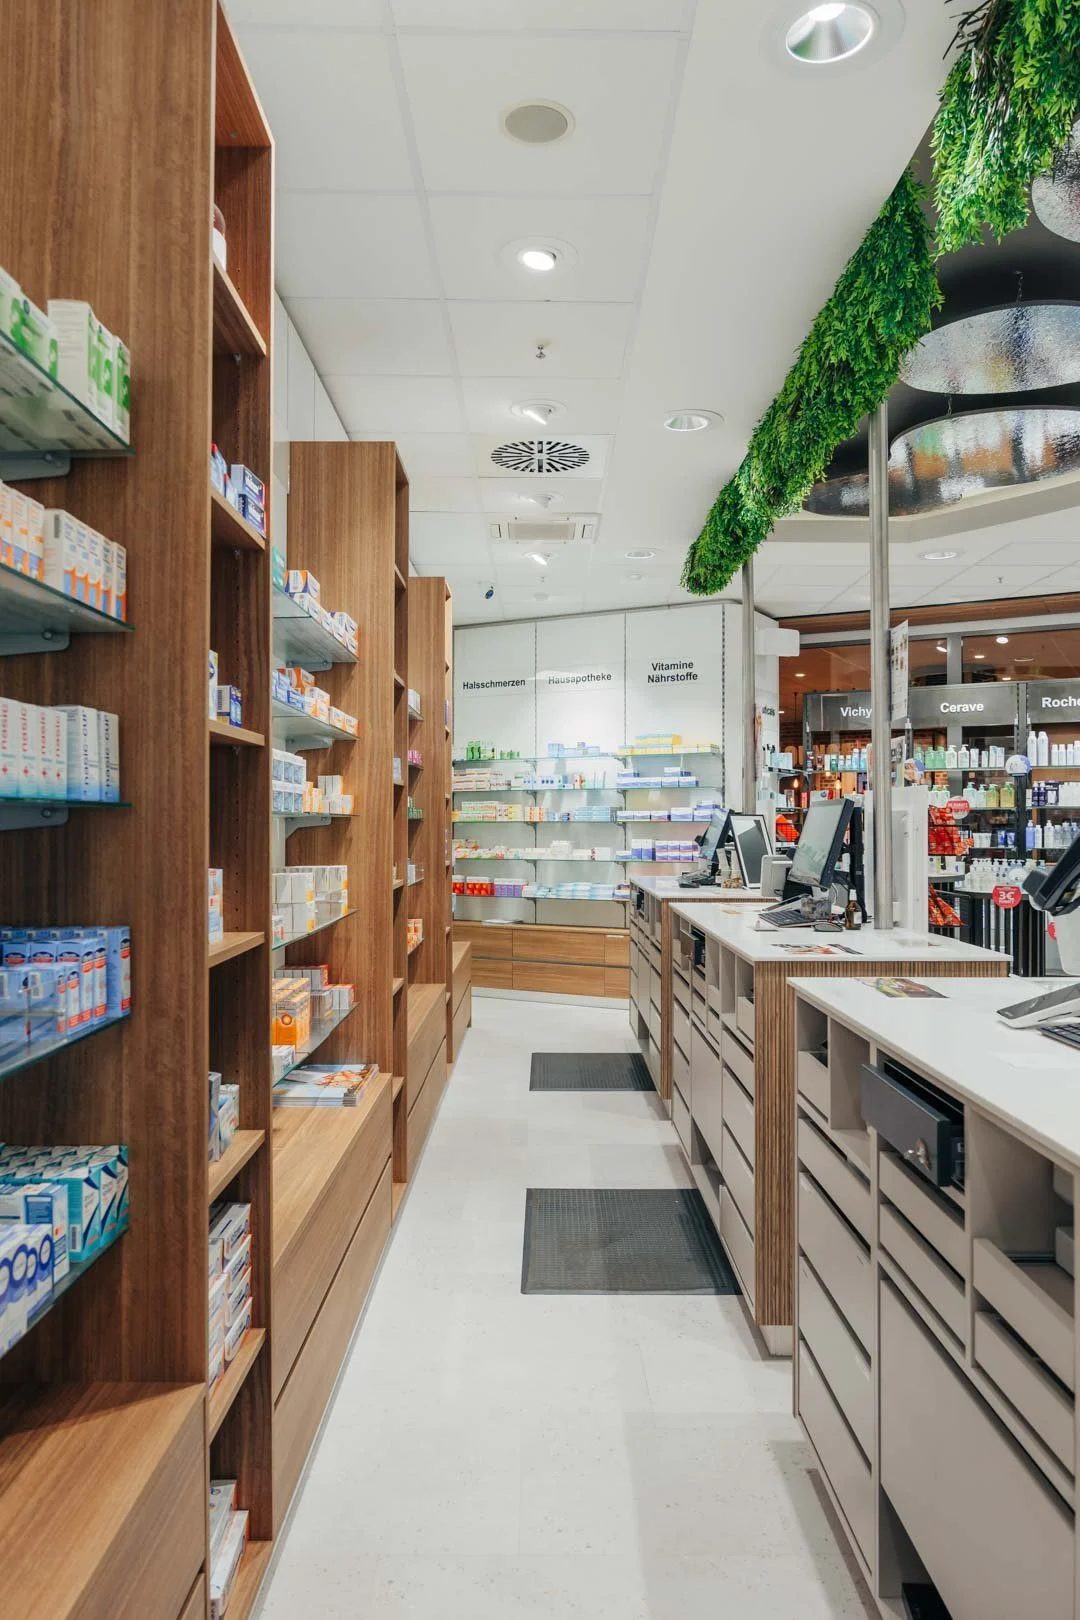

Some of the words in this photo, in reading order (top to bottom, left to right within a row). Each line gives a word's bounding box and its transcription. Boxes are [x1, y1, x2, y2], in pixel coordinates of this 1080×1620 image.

[652, 660, 694, 672] Vitamine
[548, 673, 612, 685] Hausapotheke
[648, 671, 698, 683] Nährstoffe
[463, 678, 526, 690] Halsschmerzen
[840, 706, 873, 719] Vichy
[940, 702, 984, 713] Cerave
